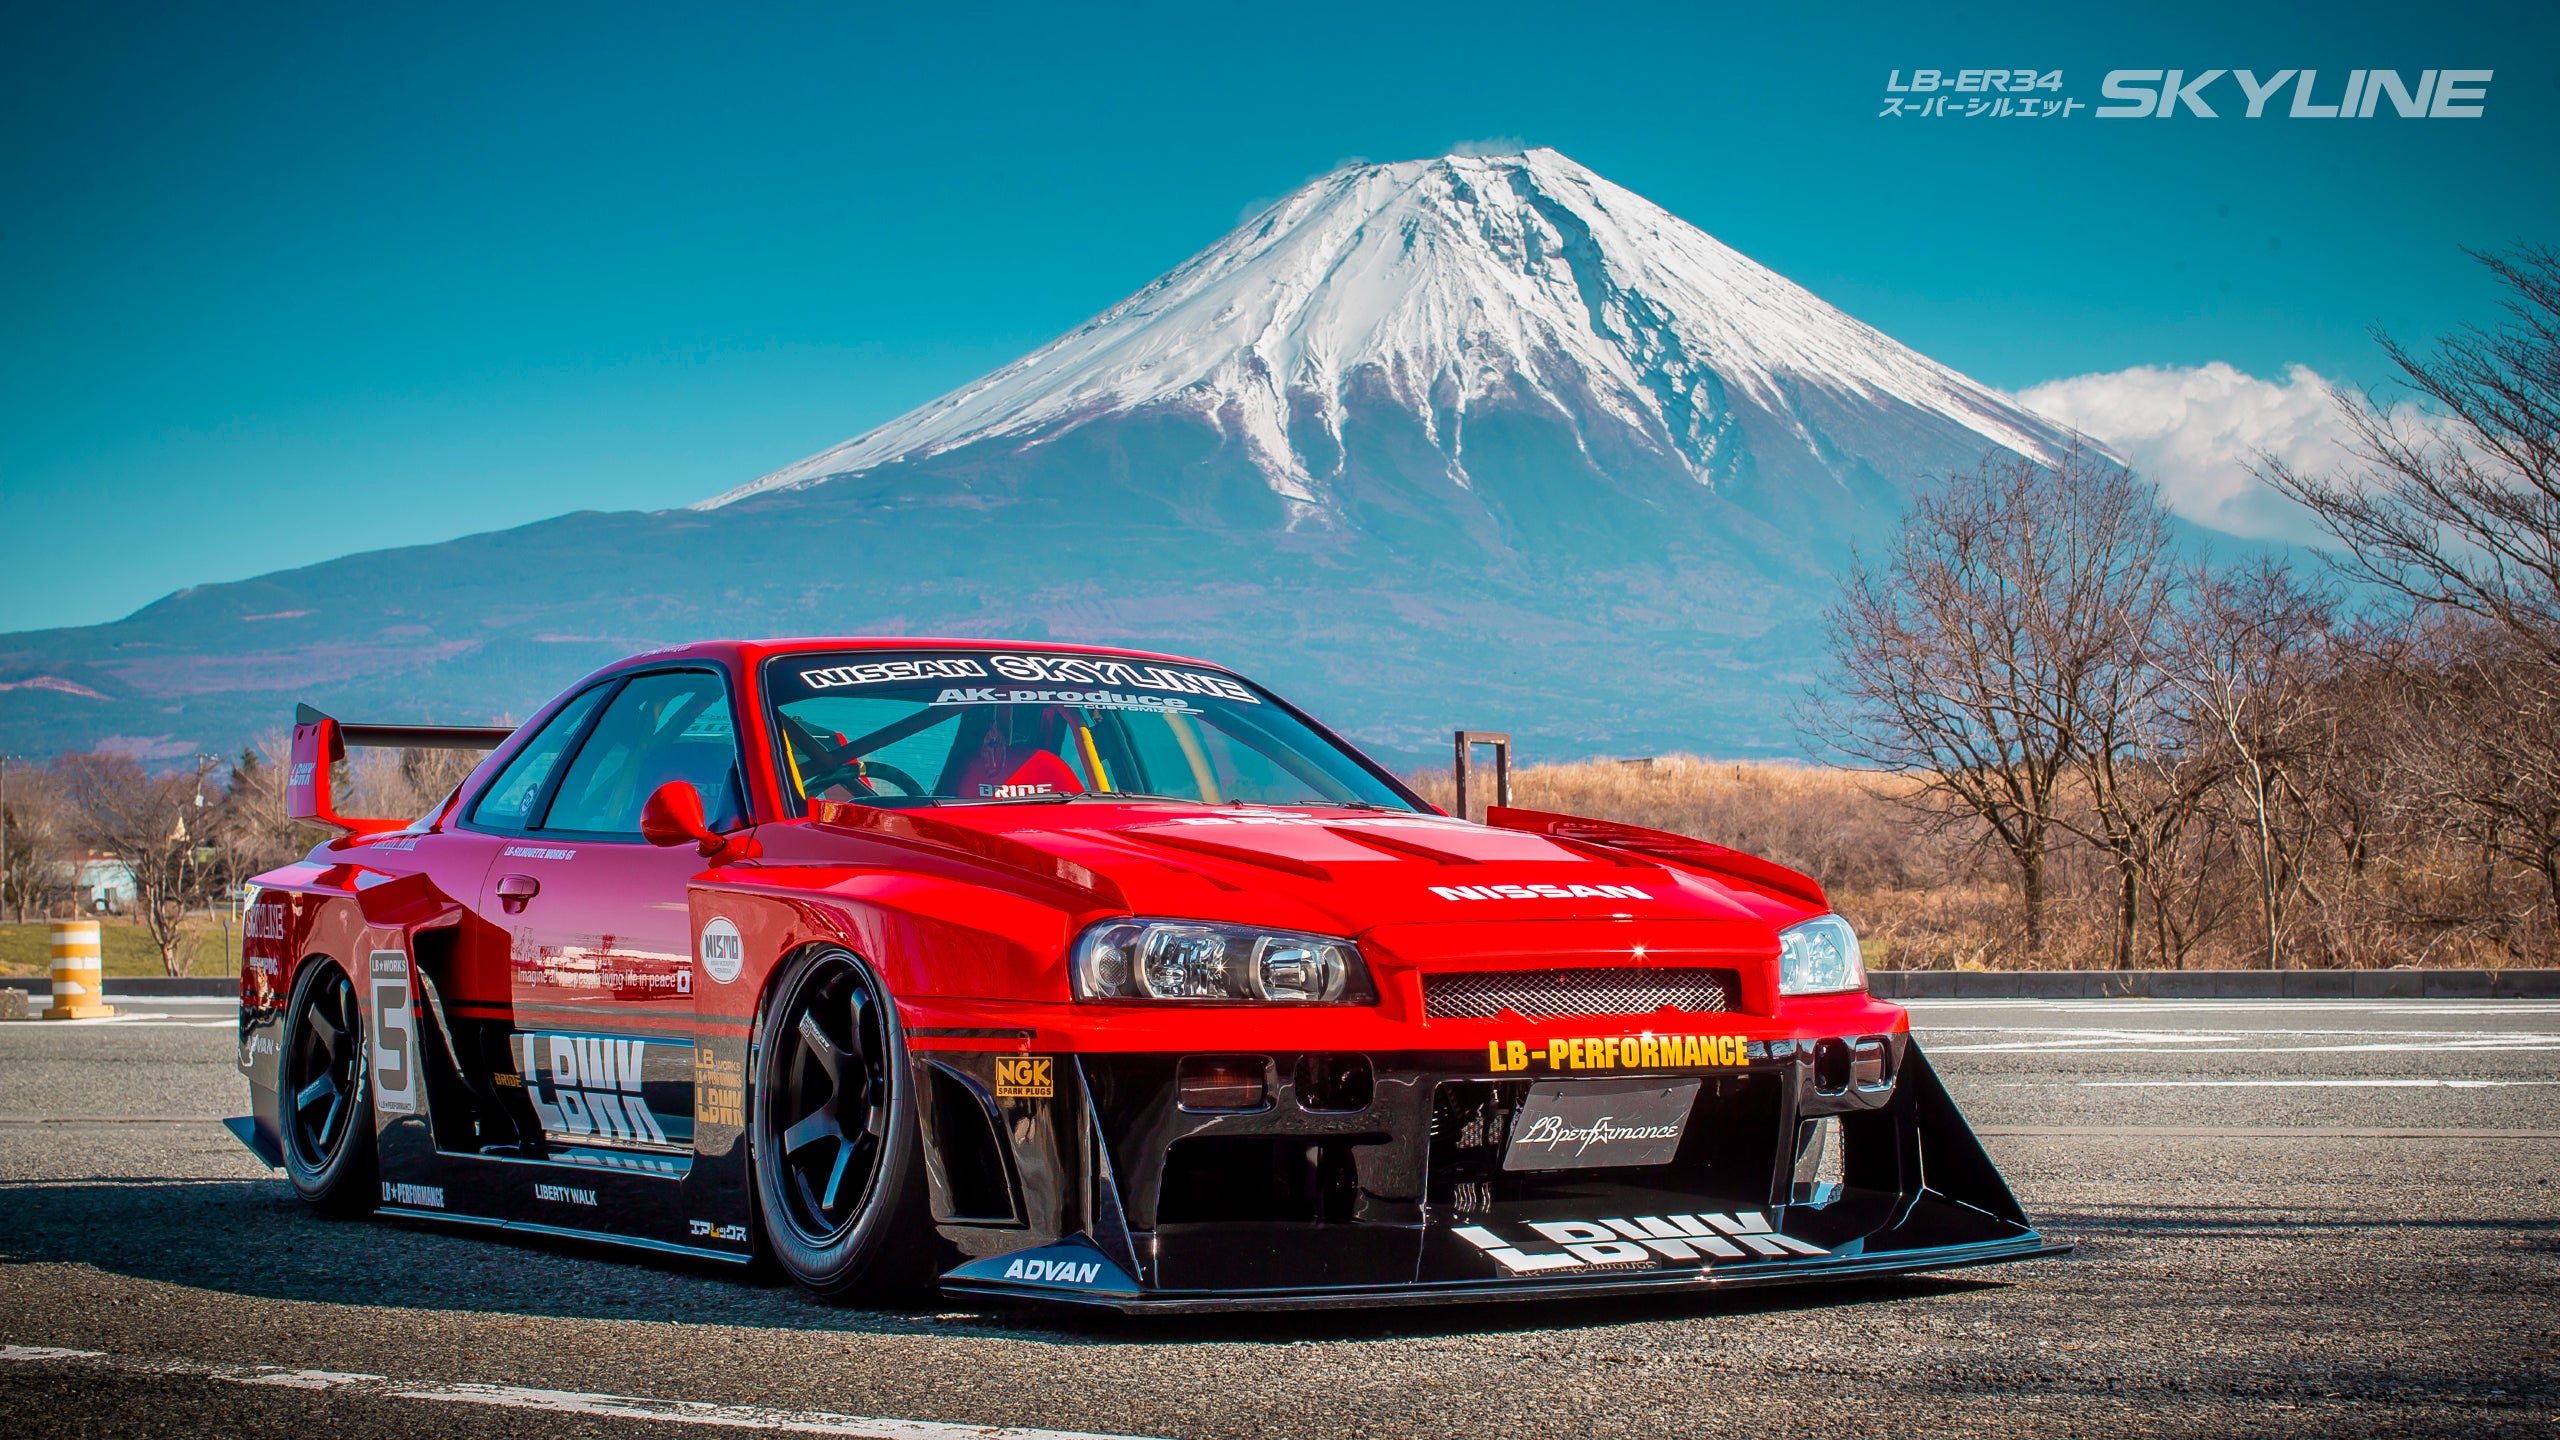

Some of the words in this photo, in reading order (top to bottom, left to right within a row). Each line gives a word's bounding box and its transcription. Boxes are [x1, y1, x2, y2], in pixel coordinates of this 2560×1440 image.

[801, 658, 988, 689] NISSAN
[990, 656, 1262, 705] SKYLINE
[936, 688, 1189, 708] AK-produce
[1428, 884, 1655, 900] NISSAN
[705, 934, 739, 960] NISMO
[649, 973, 676, 991] peace
[377, 985, 408, 1092] 5
[998, 1059, 1051, 1086] NGK
[998, 1087, 1024, 1096] SPARK
[1025, 1088, 1052, 1096] PLUGS
[534, 1183, 571, 1203] LIBERTY
[570, 1188, 598, 1206] WALK
[1003, 1258, 1101, 1284] ADVAN
